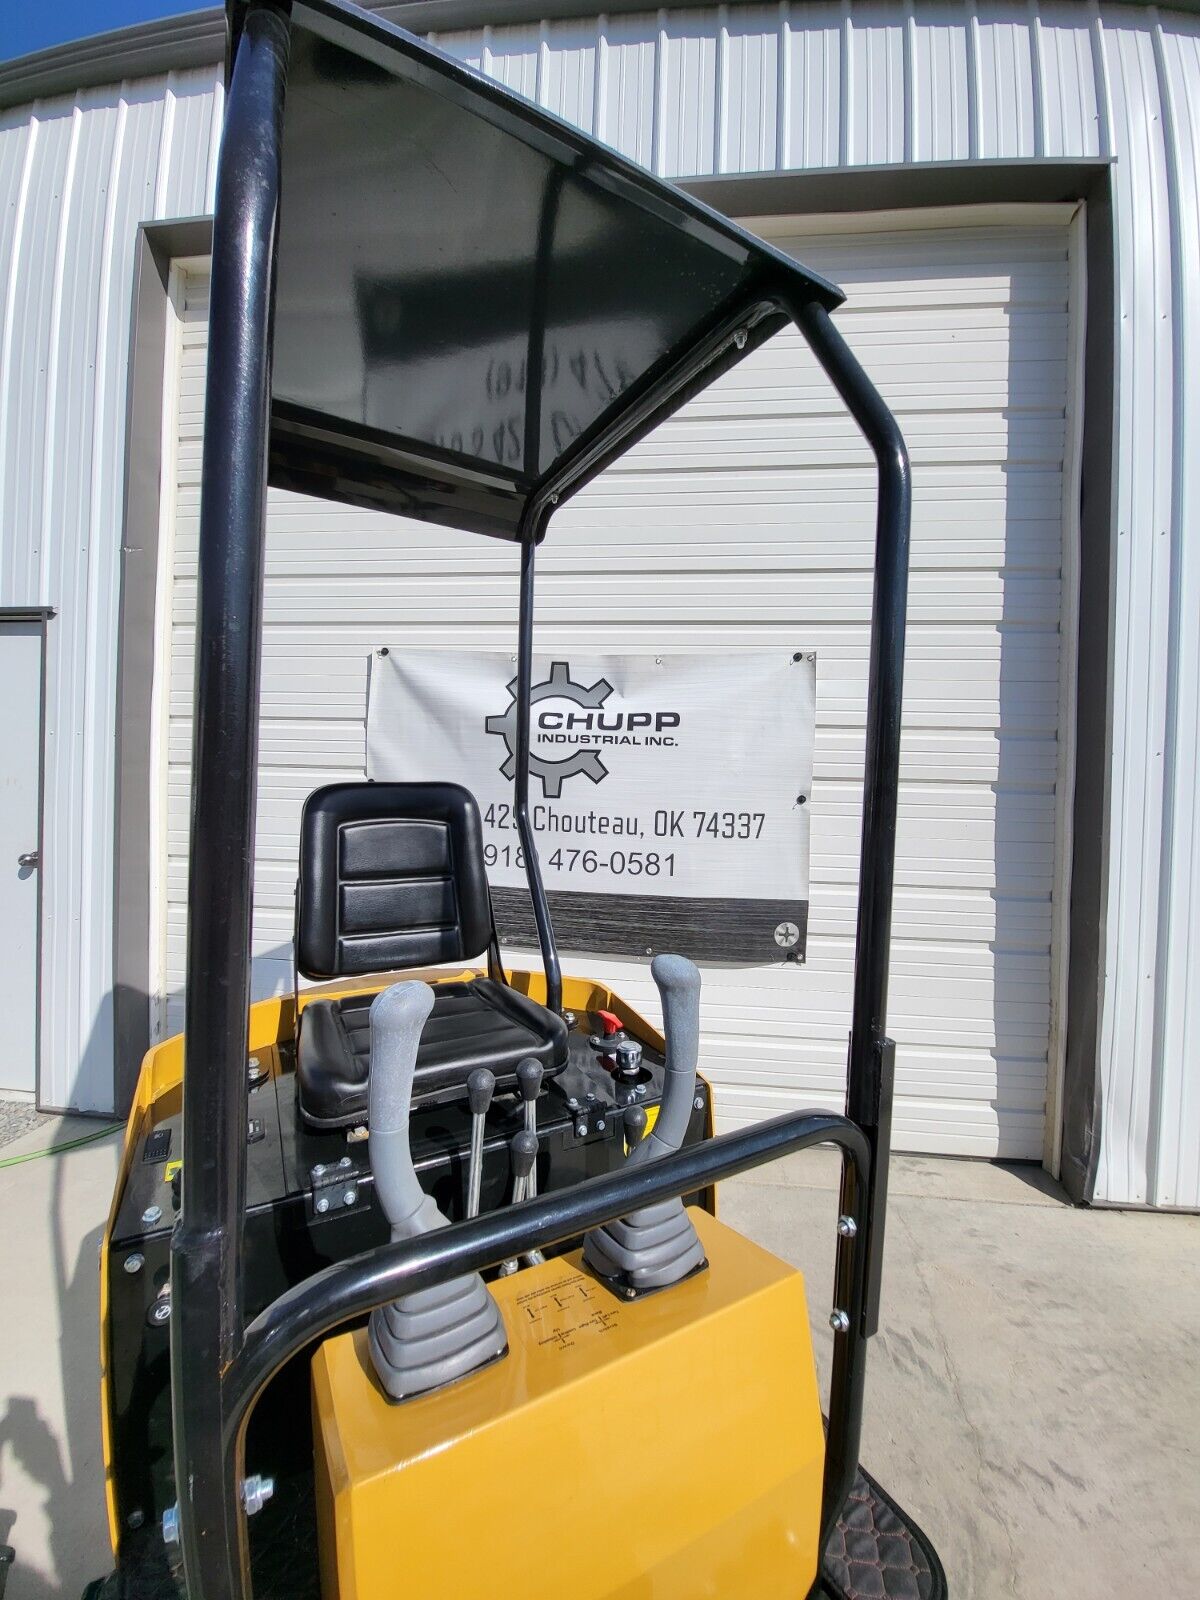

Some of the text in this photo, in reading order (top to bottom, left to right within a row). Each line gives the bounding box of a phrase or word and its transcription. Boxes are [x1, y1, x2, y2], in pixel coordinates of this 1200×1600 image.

[538, 712, 681, 732] CHUPP
[537, 733, 679, 747] INDUSTRIAL INC.
[533, 805, 645, 840] Chouteau,
[654, 809, 685, 838] OK
[693, 811, 766, 839] 74337
[548, 848, 675, 877] 476-0581
